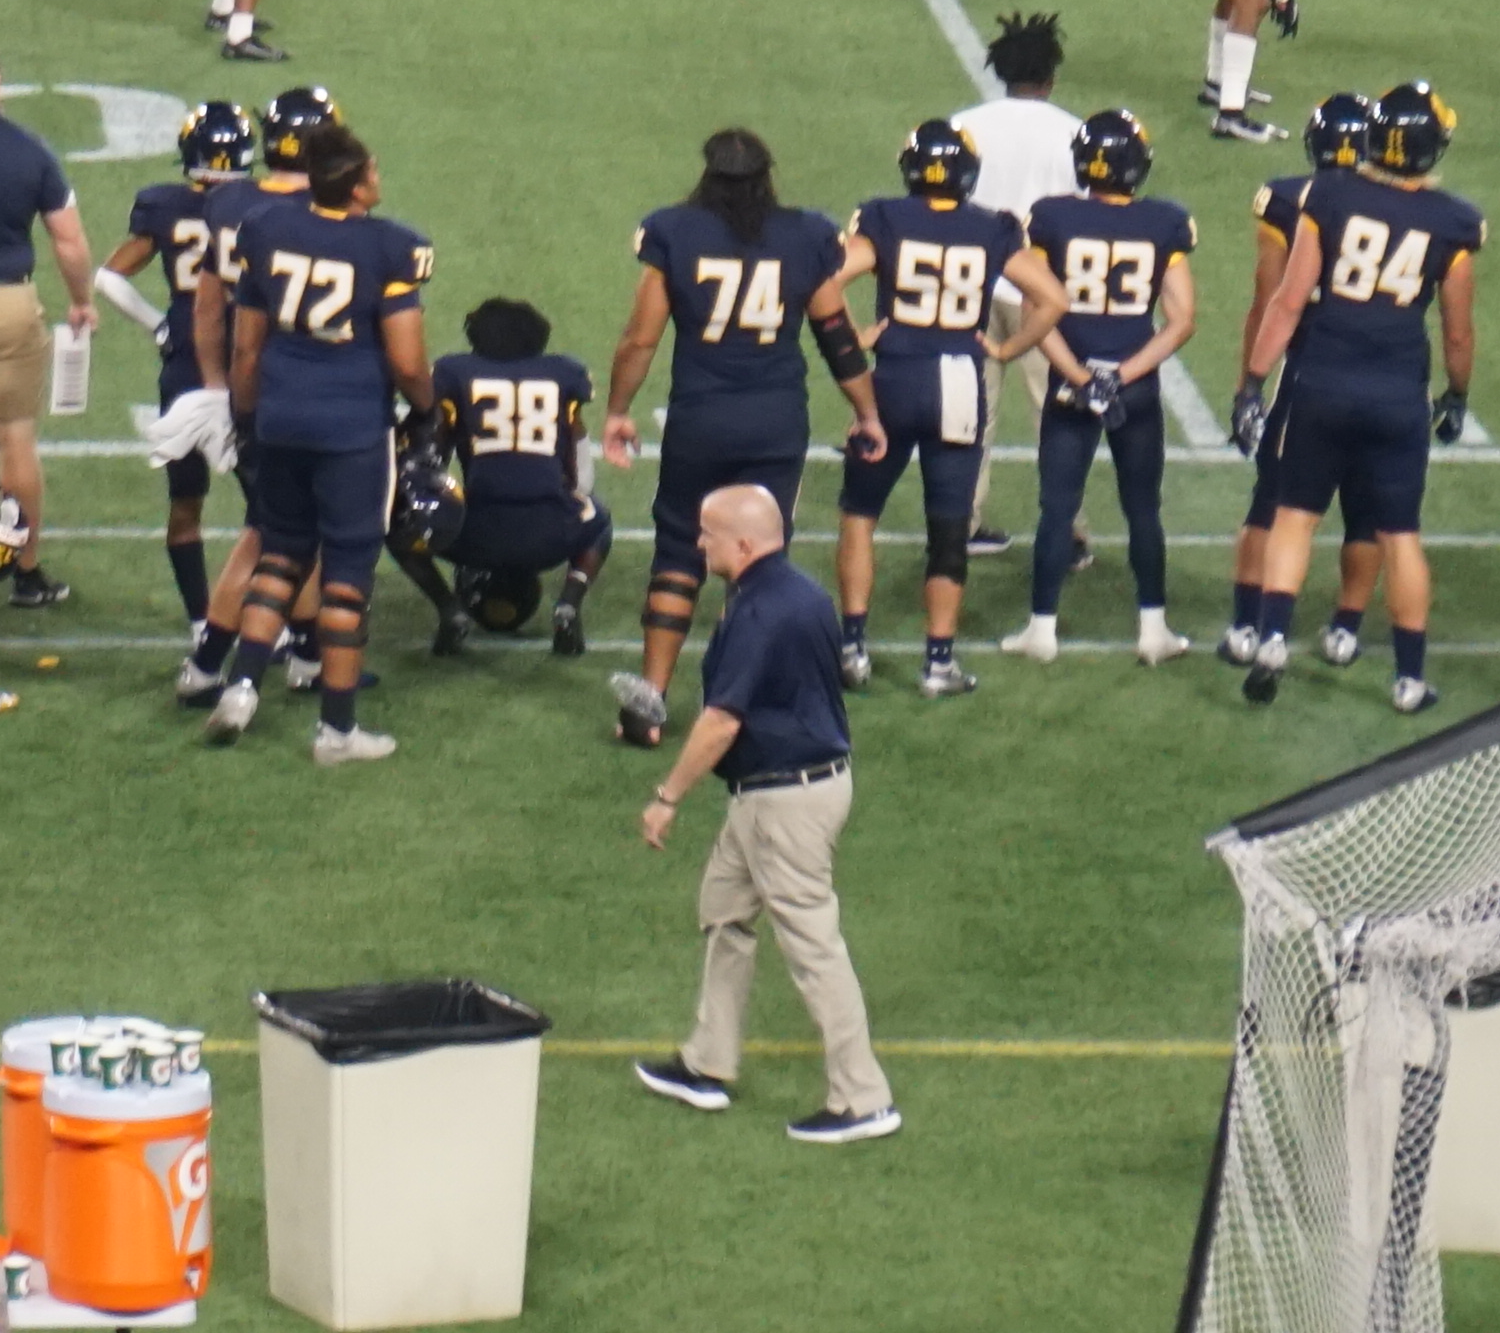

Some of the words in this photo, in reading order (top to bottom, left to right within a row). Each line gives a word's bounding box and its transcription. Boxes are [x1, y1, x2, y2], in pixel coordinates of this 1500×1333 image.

[270, 249, 355, 344] 72
[695, 258, 785, 344] 74
[893, 239, 987, 330] 58
[1065, 238, 1157, 316] 83
[1331, 215, 1431, 308] 84
[470, 378, 562, 456] 38
[178, 1143, 209, 1201] G
